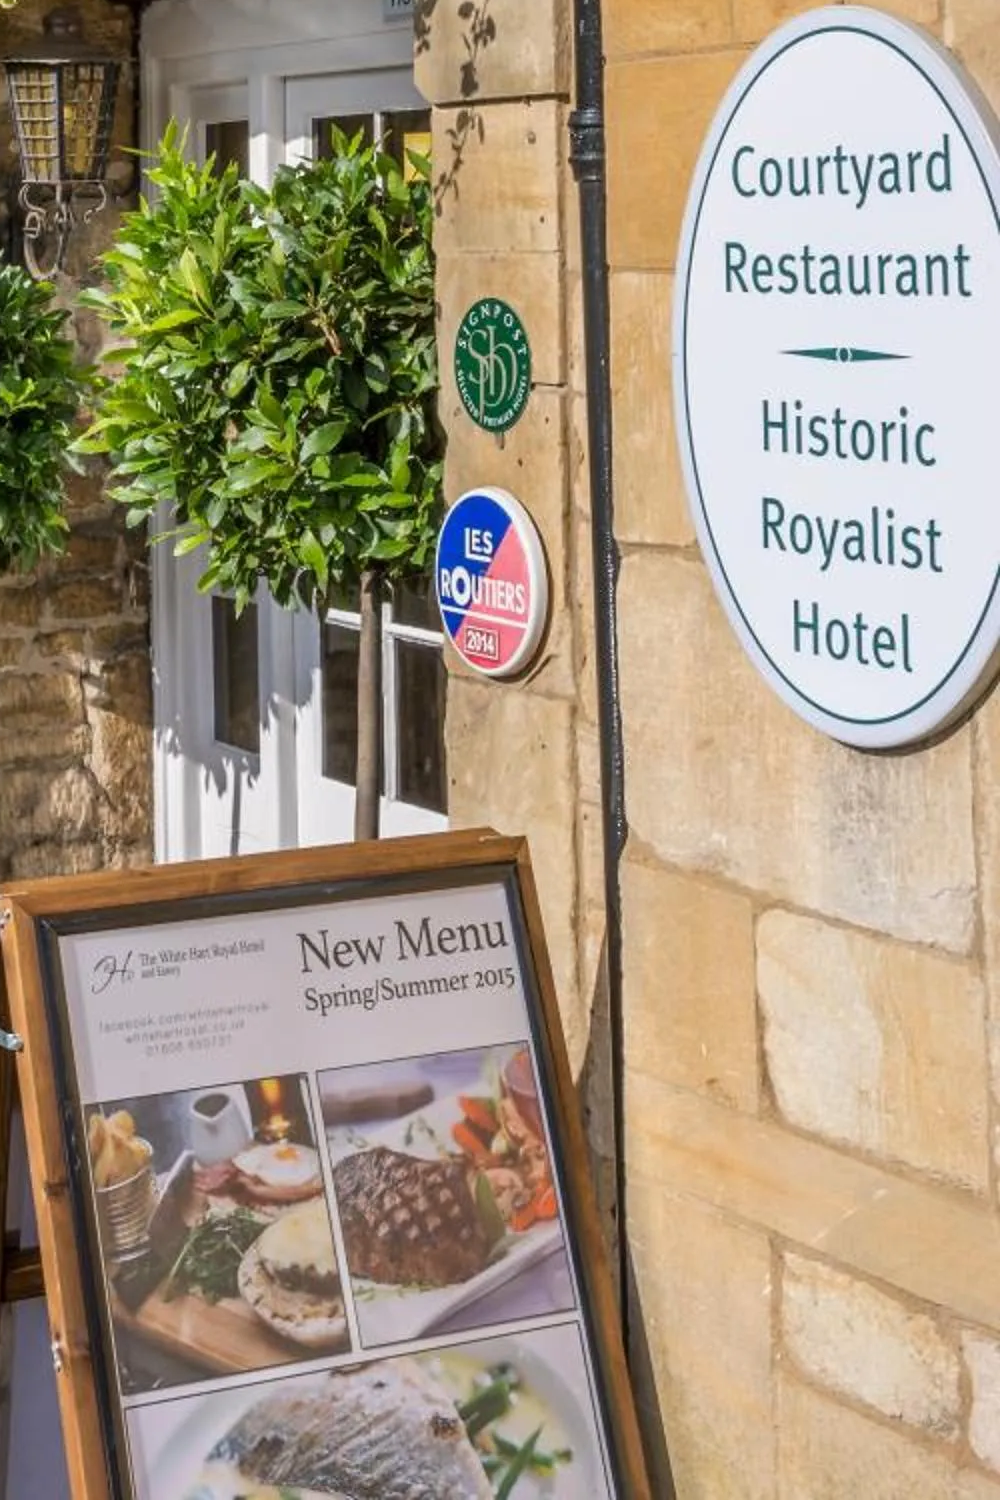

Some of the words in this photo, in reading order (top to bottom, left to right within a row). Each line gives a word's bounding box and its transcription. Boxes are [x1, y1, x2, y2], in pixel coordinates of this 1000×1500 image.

[731, 133, 953, 208] Courtyard
[724, 241, 972, 297] Restaurant
[761, 399, 937, 468] Historic
[464, 527, 494, 562] LES
[761, 496, 944, 574] Royalist
[441, 565, 526, 615] ROUTIERS
[466, 630, 496, 656] 2014
[793, 598, 913, 674] Hotel
[296, 929, 385, 973] New
[394, 916, 509, 961] Menu
[304, 971, 470, 1017] Spring/Summer
[474, 967, 516, 990] 2015
